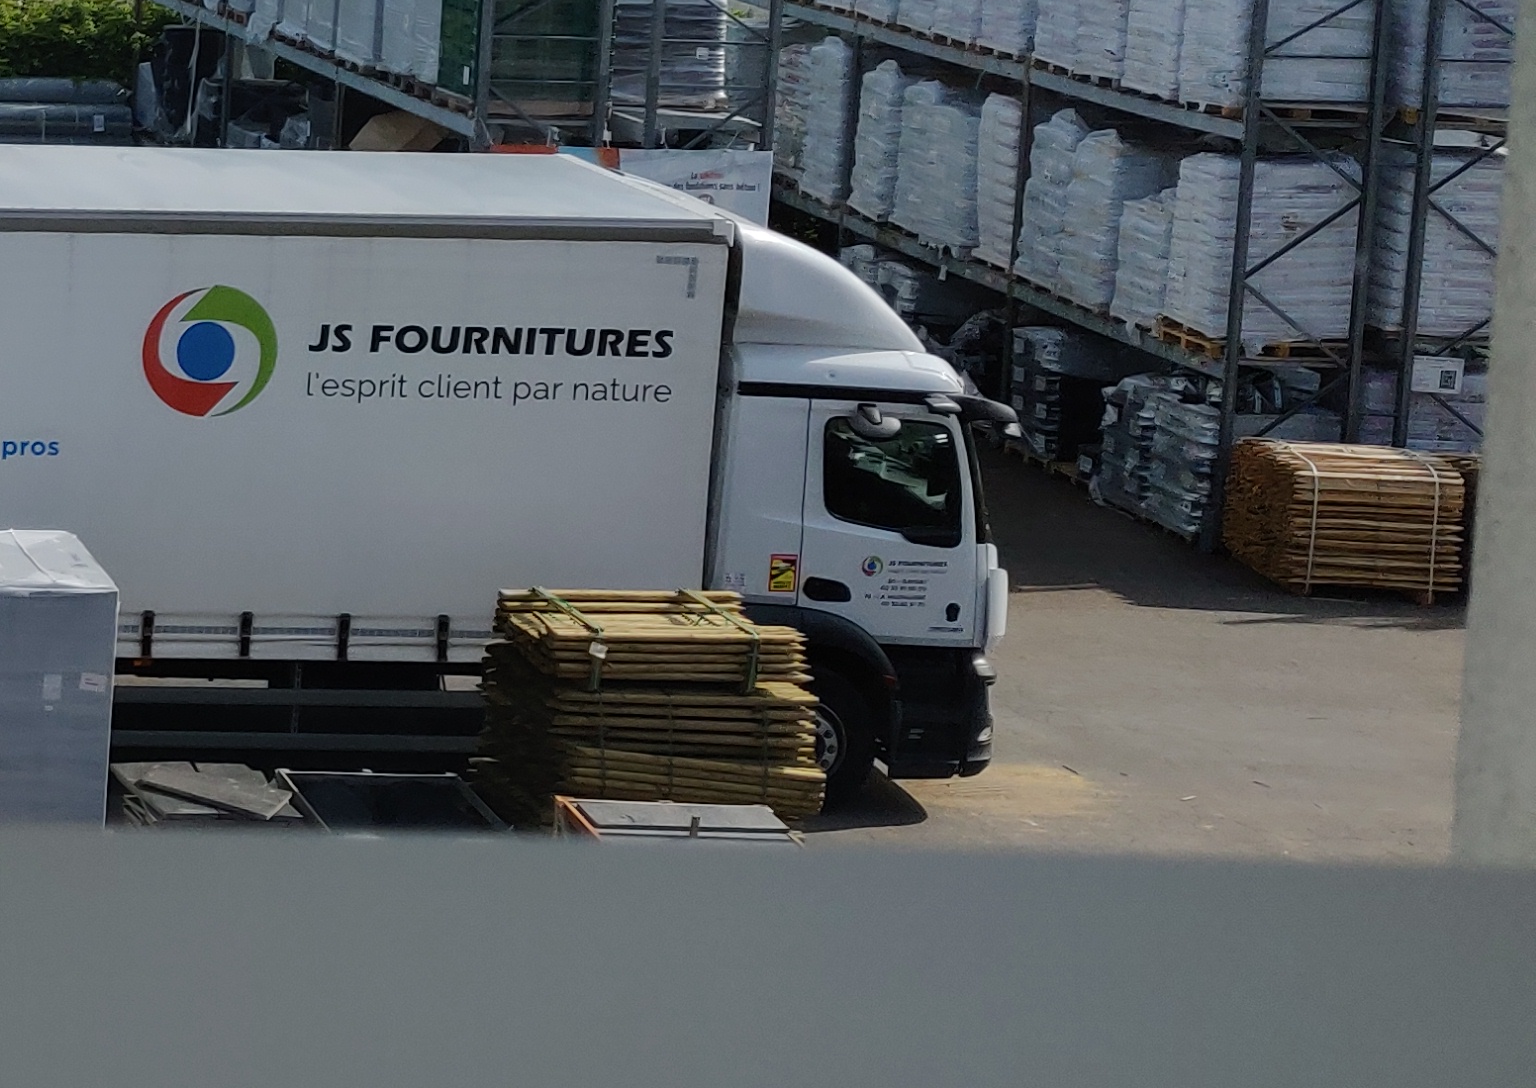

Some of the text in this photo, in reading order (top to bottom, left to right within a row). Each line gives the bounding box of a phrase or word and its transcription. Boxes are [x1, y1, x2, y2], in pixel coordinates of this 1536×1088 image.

[308, 323, 674, 359] JS FOURNITURES
[306, 371, 672, 406] l'esprit client par nature
[1, 439, 60, 460] pros
